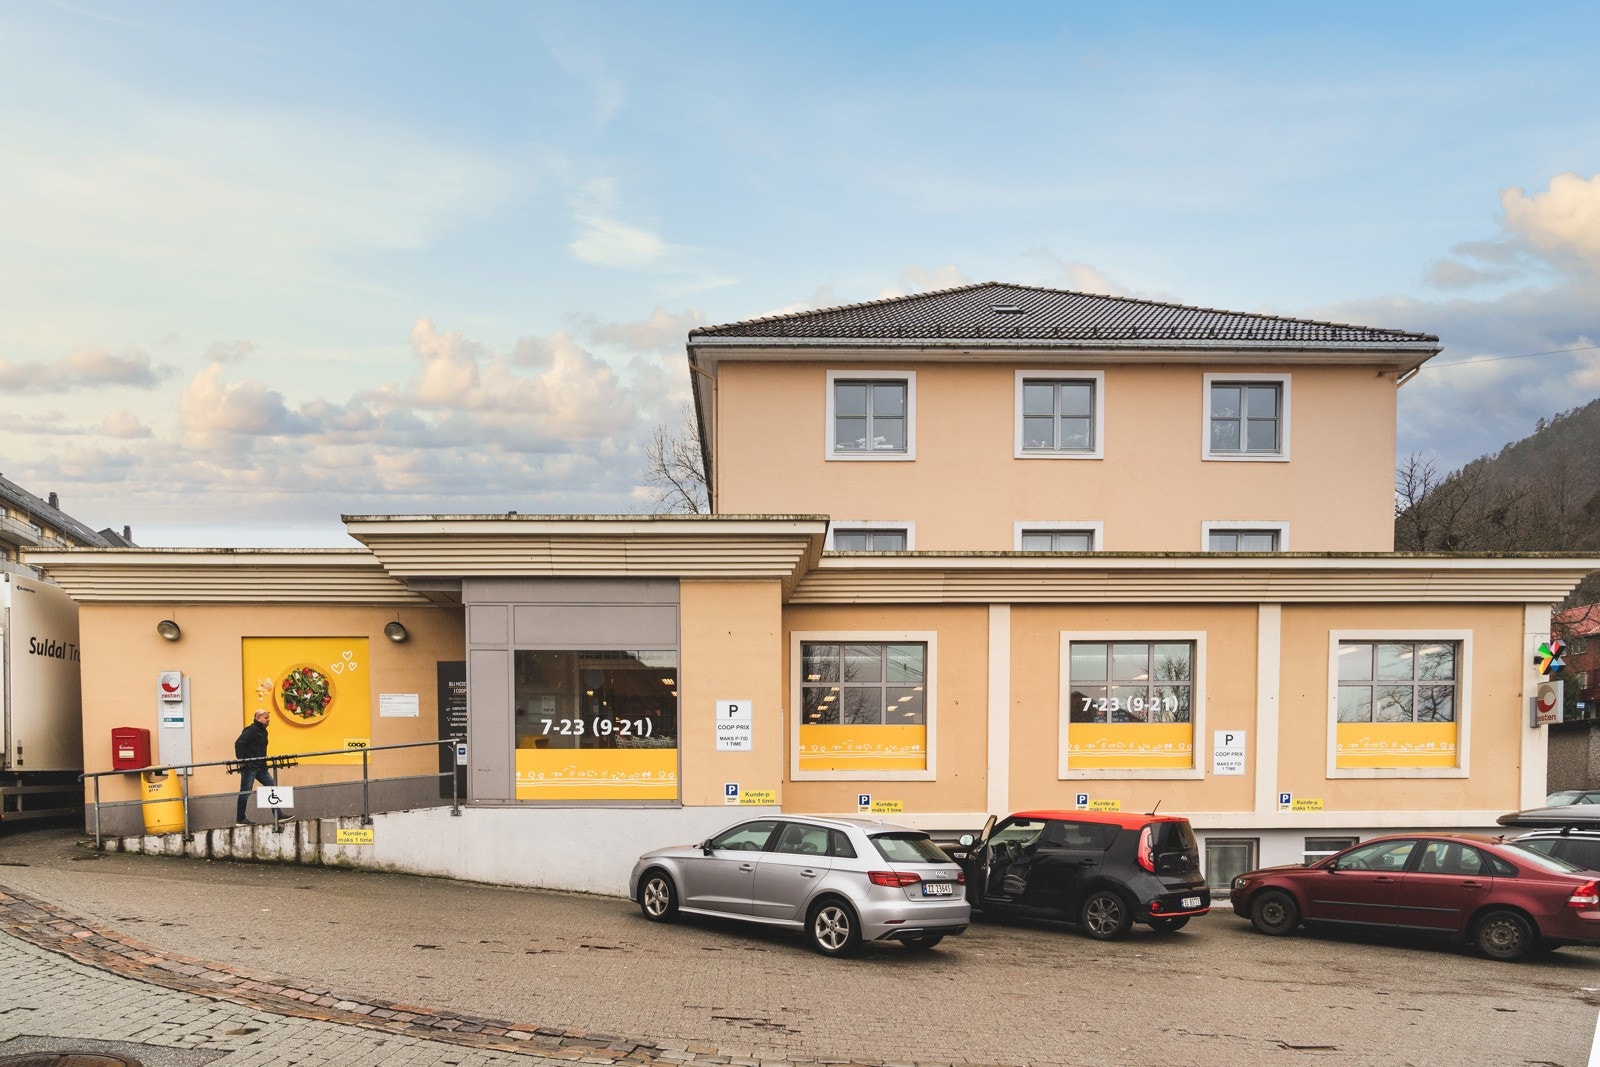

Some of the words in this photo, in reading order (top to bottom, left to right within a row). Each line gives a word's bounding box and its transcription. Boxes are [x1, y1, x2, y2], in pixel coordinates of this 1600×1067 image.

[29, 636, 66, 659] Suldal
[1081, 697, 1120, 712] 7-23
[1126, 695, 1178, 713] (9-21)
[729, 705, 738, 717] P
[541, 719, 585, 736] 7-23
[592, 717, 653, 738] (9-21)
[1225, 734, 1234, 745] P
[728, 785, 735, 795] P
[861, 796, 868, 805] P
[1079, 795, 1086, 804] P
[1282, 794, 1289, 803] P
[928, 884, 934, 893] ZZ
